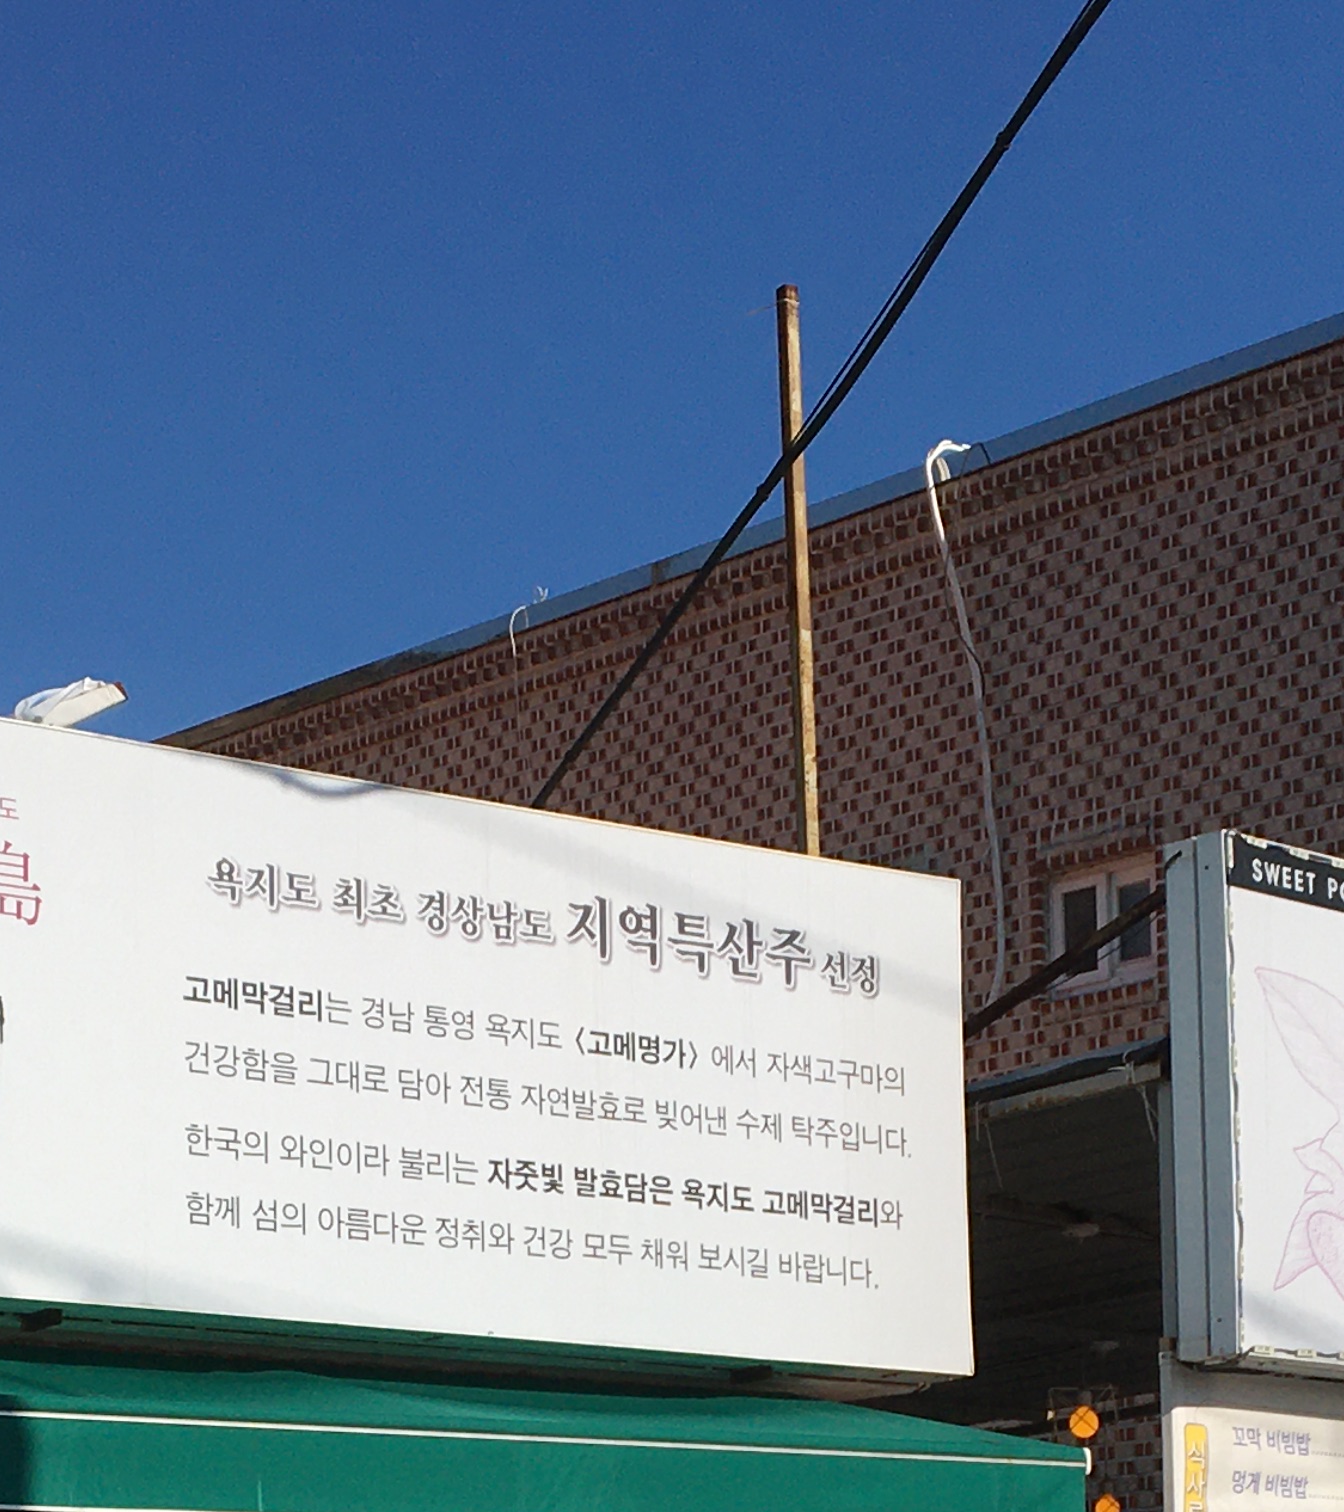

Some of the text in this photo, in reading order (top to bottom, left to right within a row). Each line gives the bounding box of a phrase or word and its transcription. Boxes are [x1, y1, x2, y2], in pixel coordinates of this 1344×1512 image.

[207, 857, 877, 993] 욕지도 최초 경상남도 지역특산주 선정
[1252, 858, 1316, 895] SWEET
[183, 976, 353, 1025] 고메막걸리는
[361, 996, 415, 1034] 경남
[423, 1006, 475, 1041] 통영
[485, 1014, 563, 1049] 욕지도
[711, 1044, 757, 1078] 에서
[767, 1051, 906, 1096] 자색고구마의
[184, 1041, 912, 1158] 건강함을 그대로 담아 전통 자연발효로 빚어낸 수제 탁주입니다.
[184, 1122, 904, 1230] 한국의 와인이라 불리는 자줏빛 발효담은 욕지도 고메막걸리와
[185, 1191, 880, 1289] 함께 섬의 아름다운 정취와 건강 모두 채워 보시길 바랍니다.
[1232, 1426, 1262, 1451] 꼬막
[1266, 1429, 1312, 1457] 비빔밥
[1232, 1470, 1262, 1496] 멍게
[1264, 1474, 1309, 1500] 비빔밥
